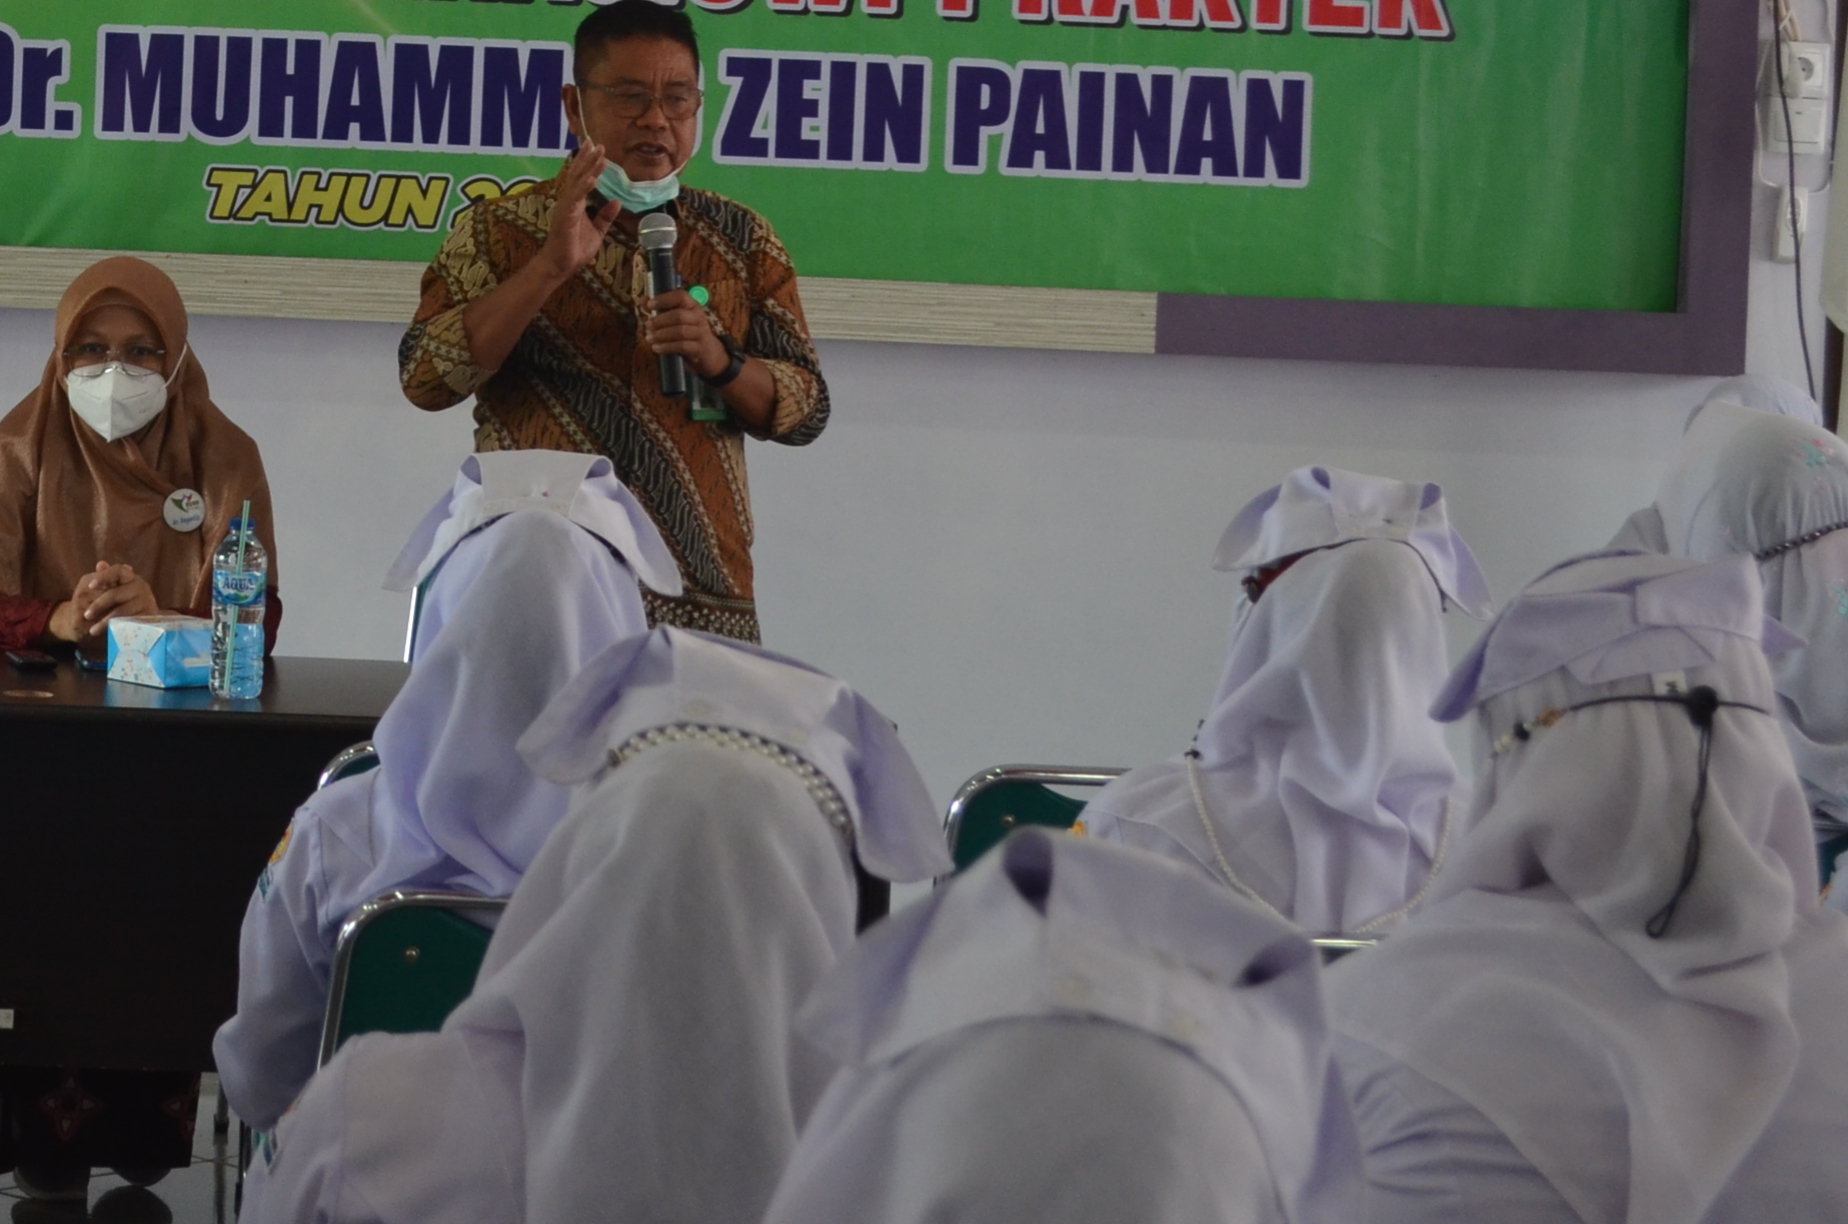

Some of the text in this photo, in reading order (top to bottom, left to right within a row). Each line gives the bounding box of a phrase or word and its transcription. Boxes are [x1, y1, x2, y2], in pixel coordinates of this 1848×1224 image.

[715, 53, 930, 172] ZEIN
[947, 56, 1312, 186] PAINAN
[208, 167, 449, 229] TAHUN
